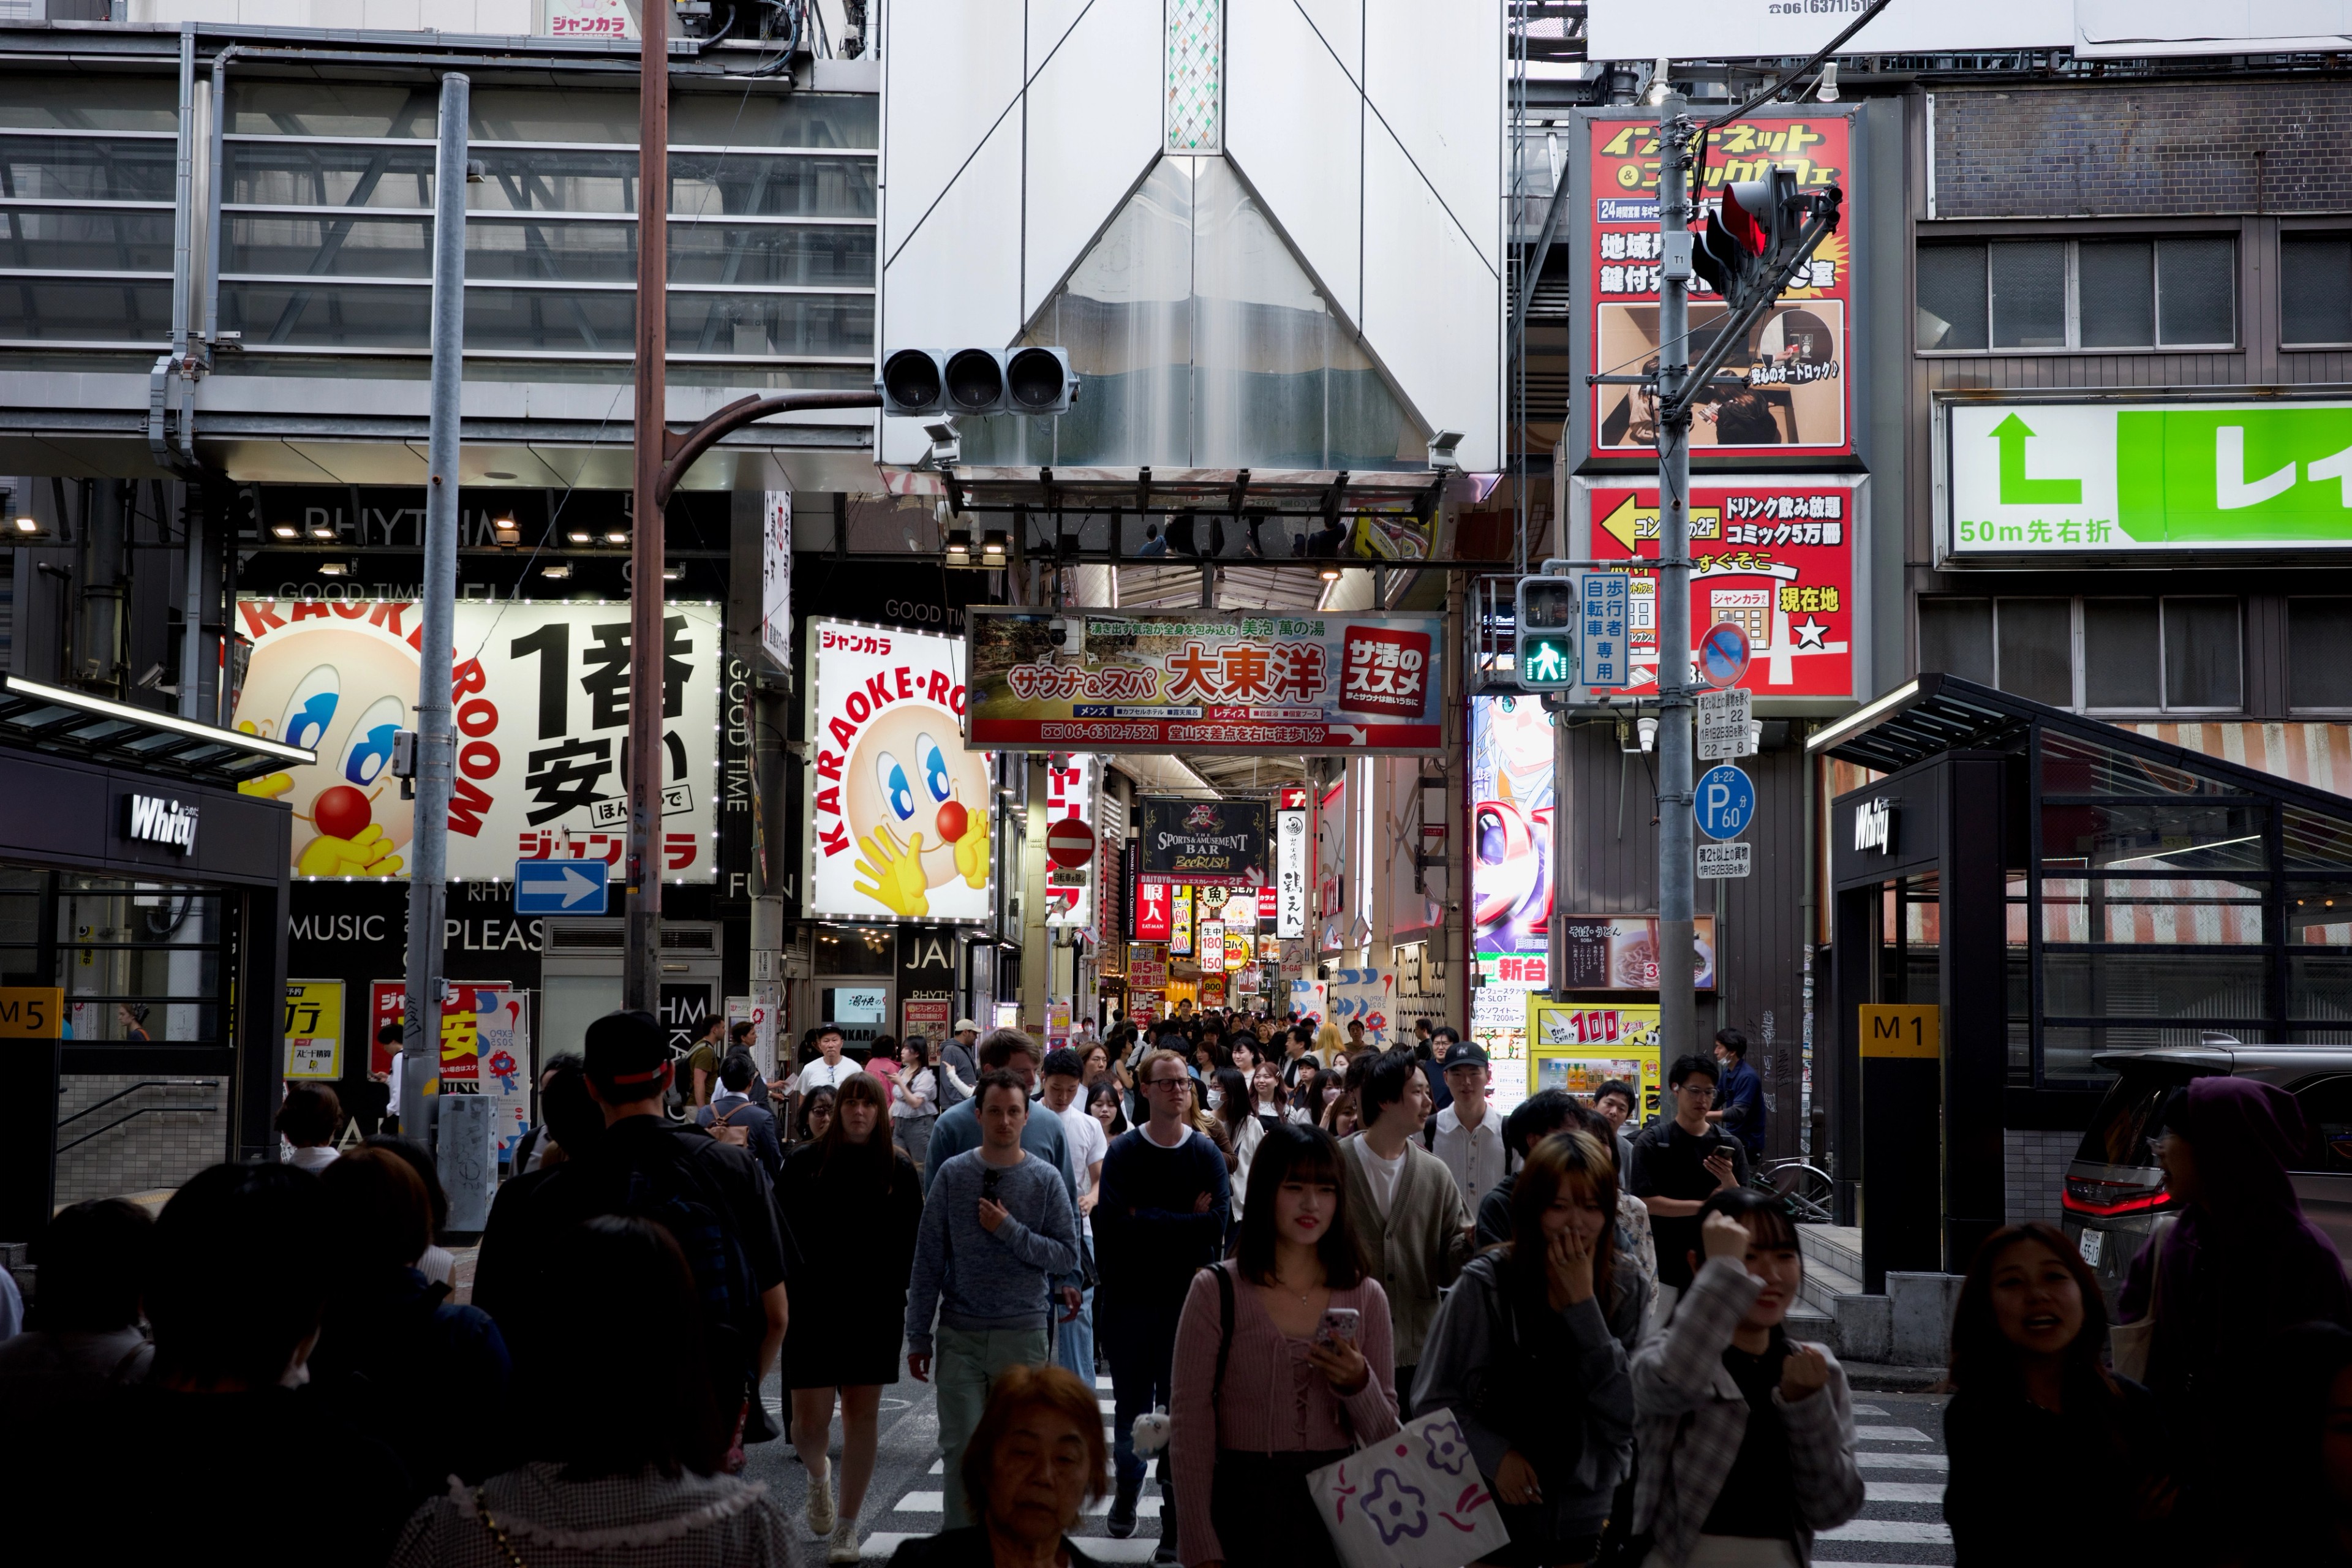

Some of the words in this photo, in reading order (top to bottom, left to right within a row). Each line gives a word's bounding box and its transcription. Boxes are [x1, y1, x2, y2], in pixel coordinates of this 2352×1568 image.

[1783, 0, 1886, 14] 06(6371)51
[553, 16, 625, 32] ジャンカラ
[1601, 201, 1640, 219] 24時間営業
[1674, 255, 1684, 264] T1
[1751, 361, 1831, 385] 安心のオートロック
[1727, 496, 1841, 519] ドリンク飲み放題
[1635, 518, 1716, 537] コンの2F
[1727, 522, 1841, 545] コミック5万冊
[1959, 518, 2113, 544] 50m先右折
[1698, 552, 1772, 571] すぐそこ
[1779, 587, 1839, 612] 現在地
[885, 599, 941, 624] GOOD
[1090, 622, 1237, 637] 湧き出す気泡が全身を包み込む
[1242, 619, 1274, 636] 美泡
[1278, 619, 1325, 638] 萬の湯
[823, 631, 892, 656] ジャンカラ
[1349, 639, 1423, 671] サ活の
[1168, 645, 1324, 699] 大東洋
[1346, 666, 1420, 696] ススメ
[1080, 706, 1108, 716] メンズ
[1213, 709, 1246, 718] レディス
[1064, 723, 1159, 741] 06-6312-7521
[1168, 725, 1325, 742] 堂山交差点を右に徒歩1分
[817, 666, 914, 858] KARAOKE
[524, 731, 687, 827] 安い
[1713, 771, 1735, 783] 8-22
[184, 805, 200, 816] うめだ
[599, 791, 682, 820] ほんで
[1708, 783, 1730, 829] P
[130, 794, 198, 856] Whity
[1722, 807, 1740, 828] 60
[1855, 797, 1889, 855] Whity
[519, 830, 697, 870] ジャンラ
[1185, 845, 1219, 855] BAR
[1699, 846, 1748, 863] 積2t以上の貨物
[1054, 872, 1085, 883] 自転車を除く
[1229, 877, 1243, 886] 2F
[1207, 886, 1224, 902] 魚
[287, 914, 385, 941] MUSIC
[1204, 927, 1221, 936] 生中
[1499, 958, 1547, 981] 新台
[1569, 1009, 1619, 1045] 100
[296, 1049, 331, 1059] スピード精算
